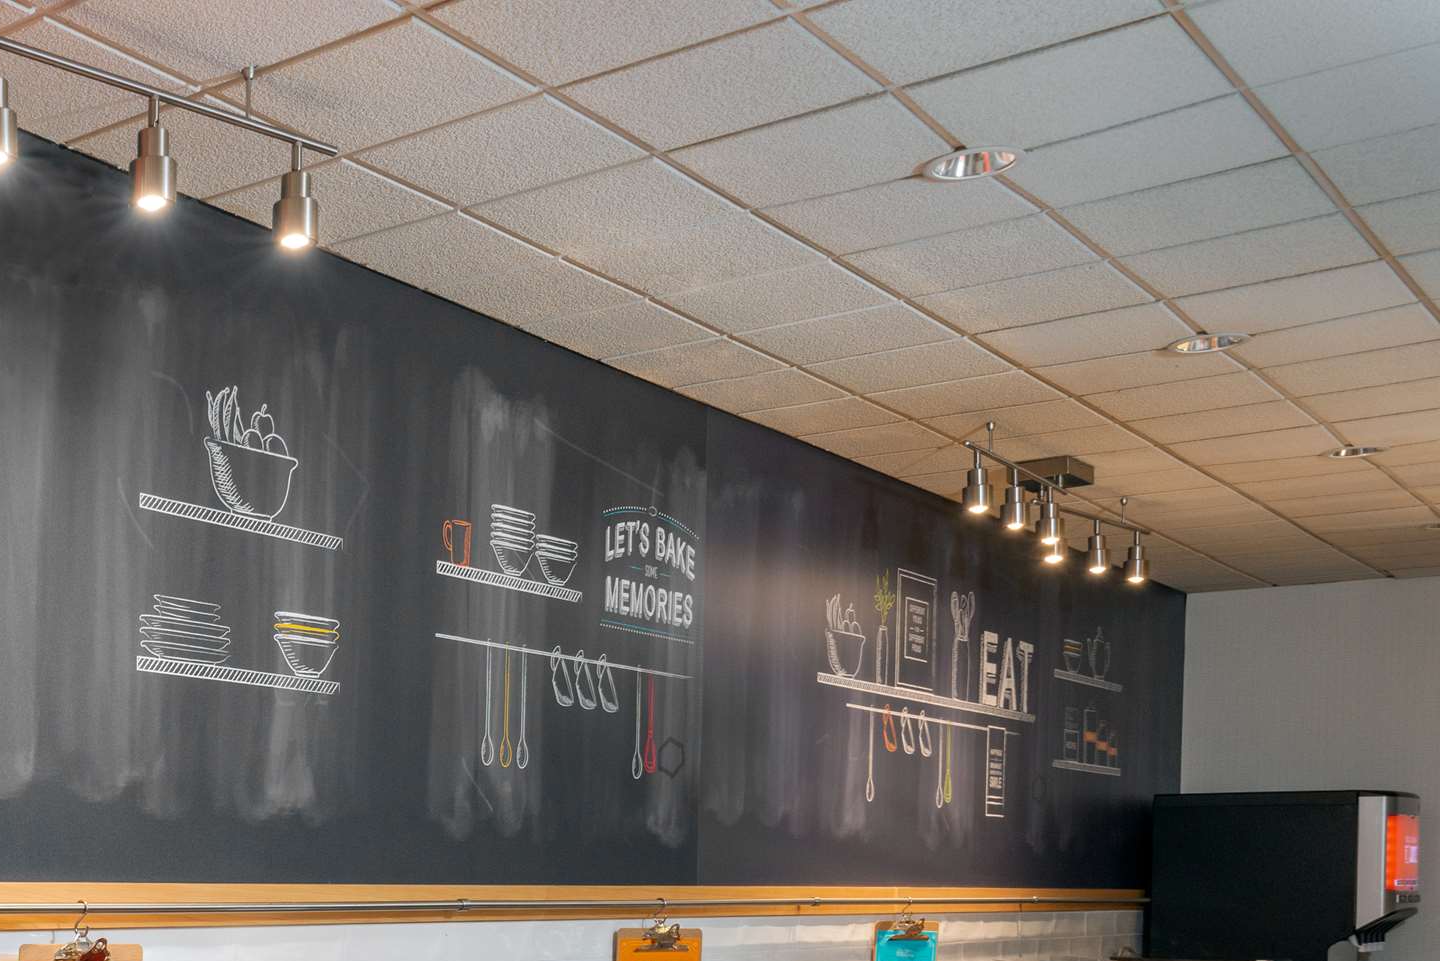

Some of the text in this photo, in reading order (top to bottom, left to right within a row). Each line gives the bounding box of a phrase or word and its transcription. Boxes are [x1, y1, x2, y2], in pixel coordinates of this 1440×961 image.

[604, 520, 696, 582] LET'S BAKE
[604, 575, 694, 629] MEMORIES
[979, 630, 1034, 714] EAT
